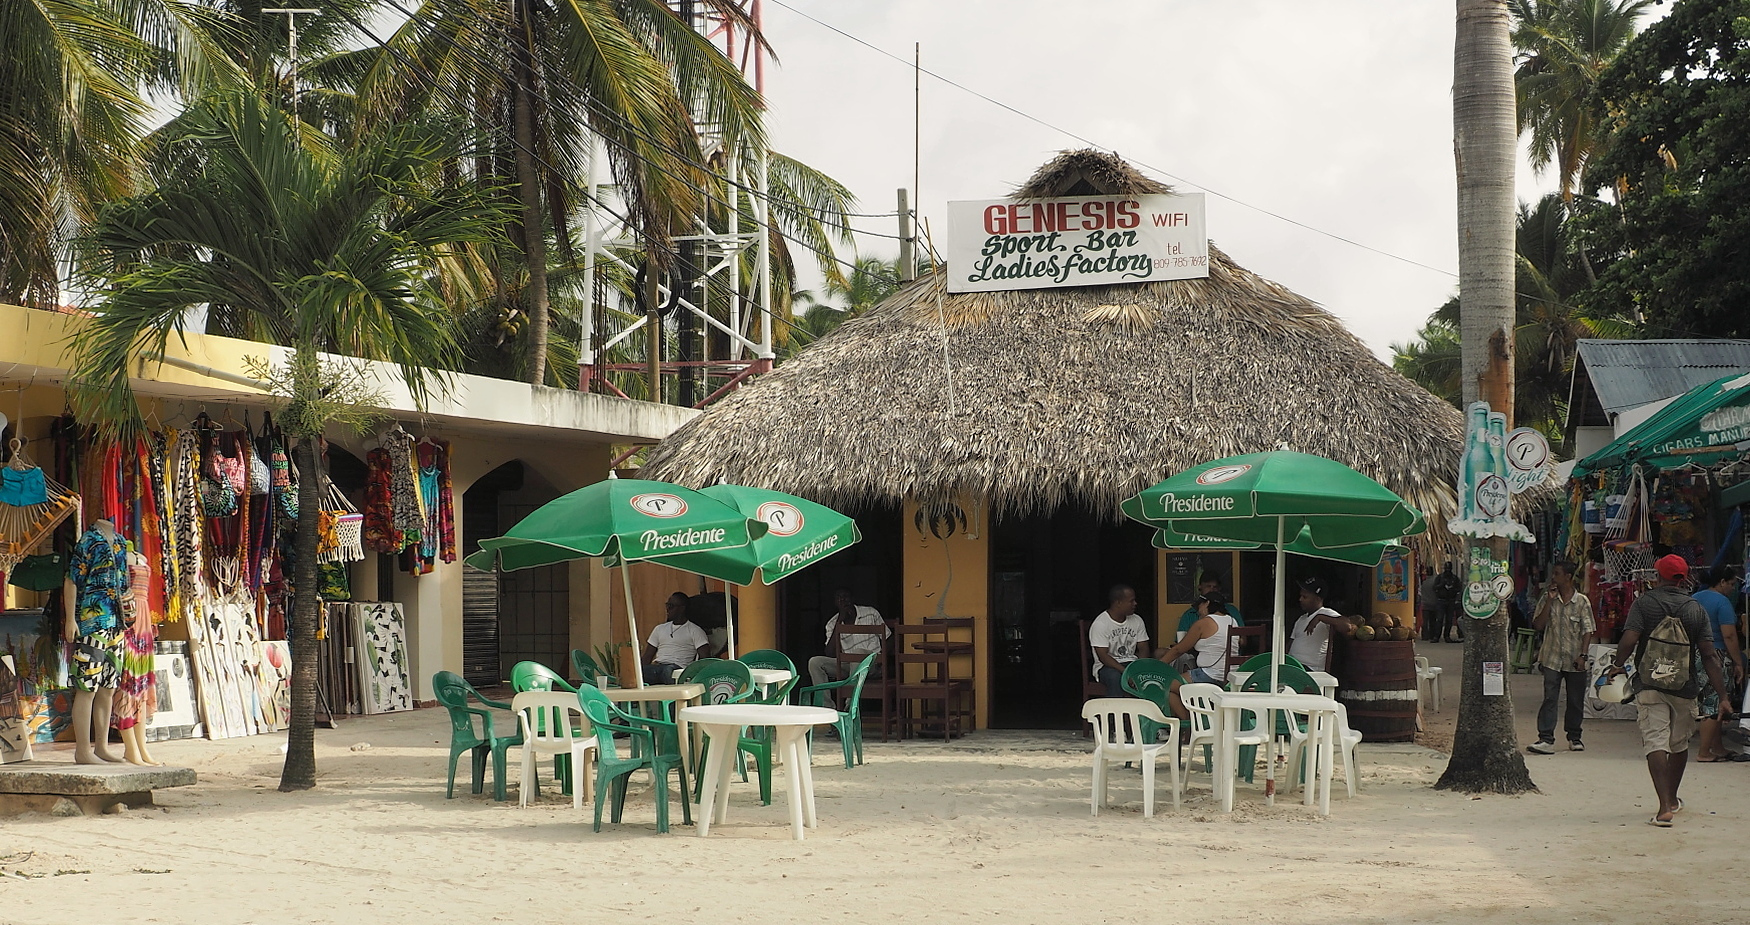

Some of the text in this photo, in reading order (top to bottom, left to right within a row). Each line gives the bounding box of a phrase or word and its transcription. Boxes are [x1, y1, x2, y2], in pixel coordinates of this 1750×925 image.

[983, 200, 1141, 236] GENESIS
[1151, 212, 1188, 228] WIFI
[1073, 230, 1138, 254] Bar
[1516, 442, 1536, 461] P
[1159, 493, 1234, 513] Presidente
[640, 527, 725, 551] Presidente
[778, 533, 838, 573] Presidente
